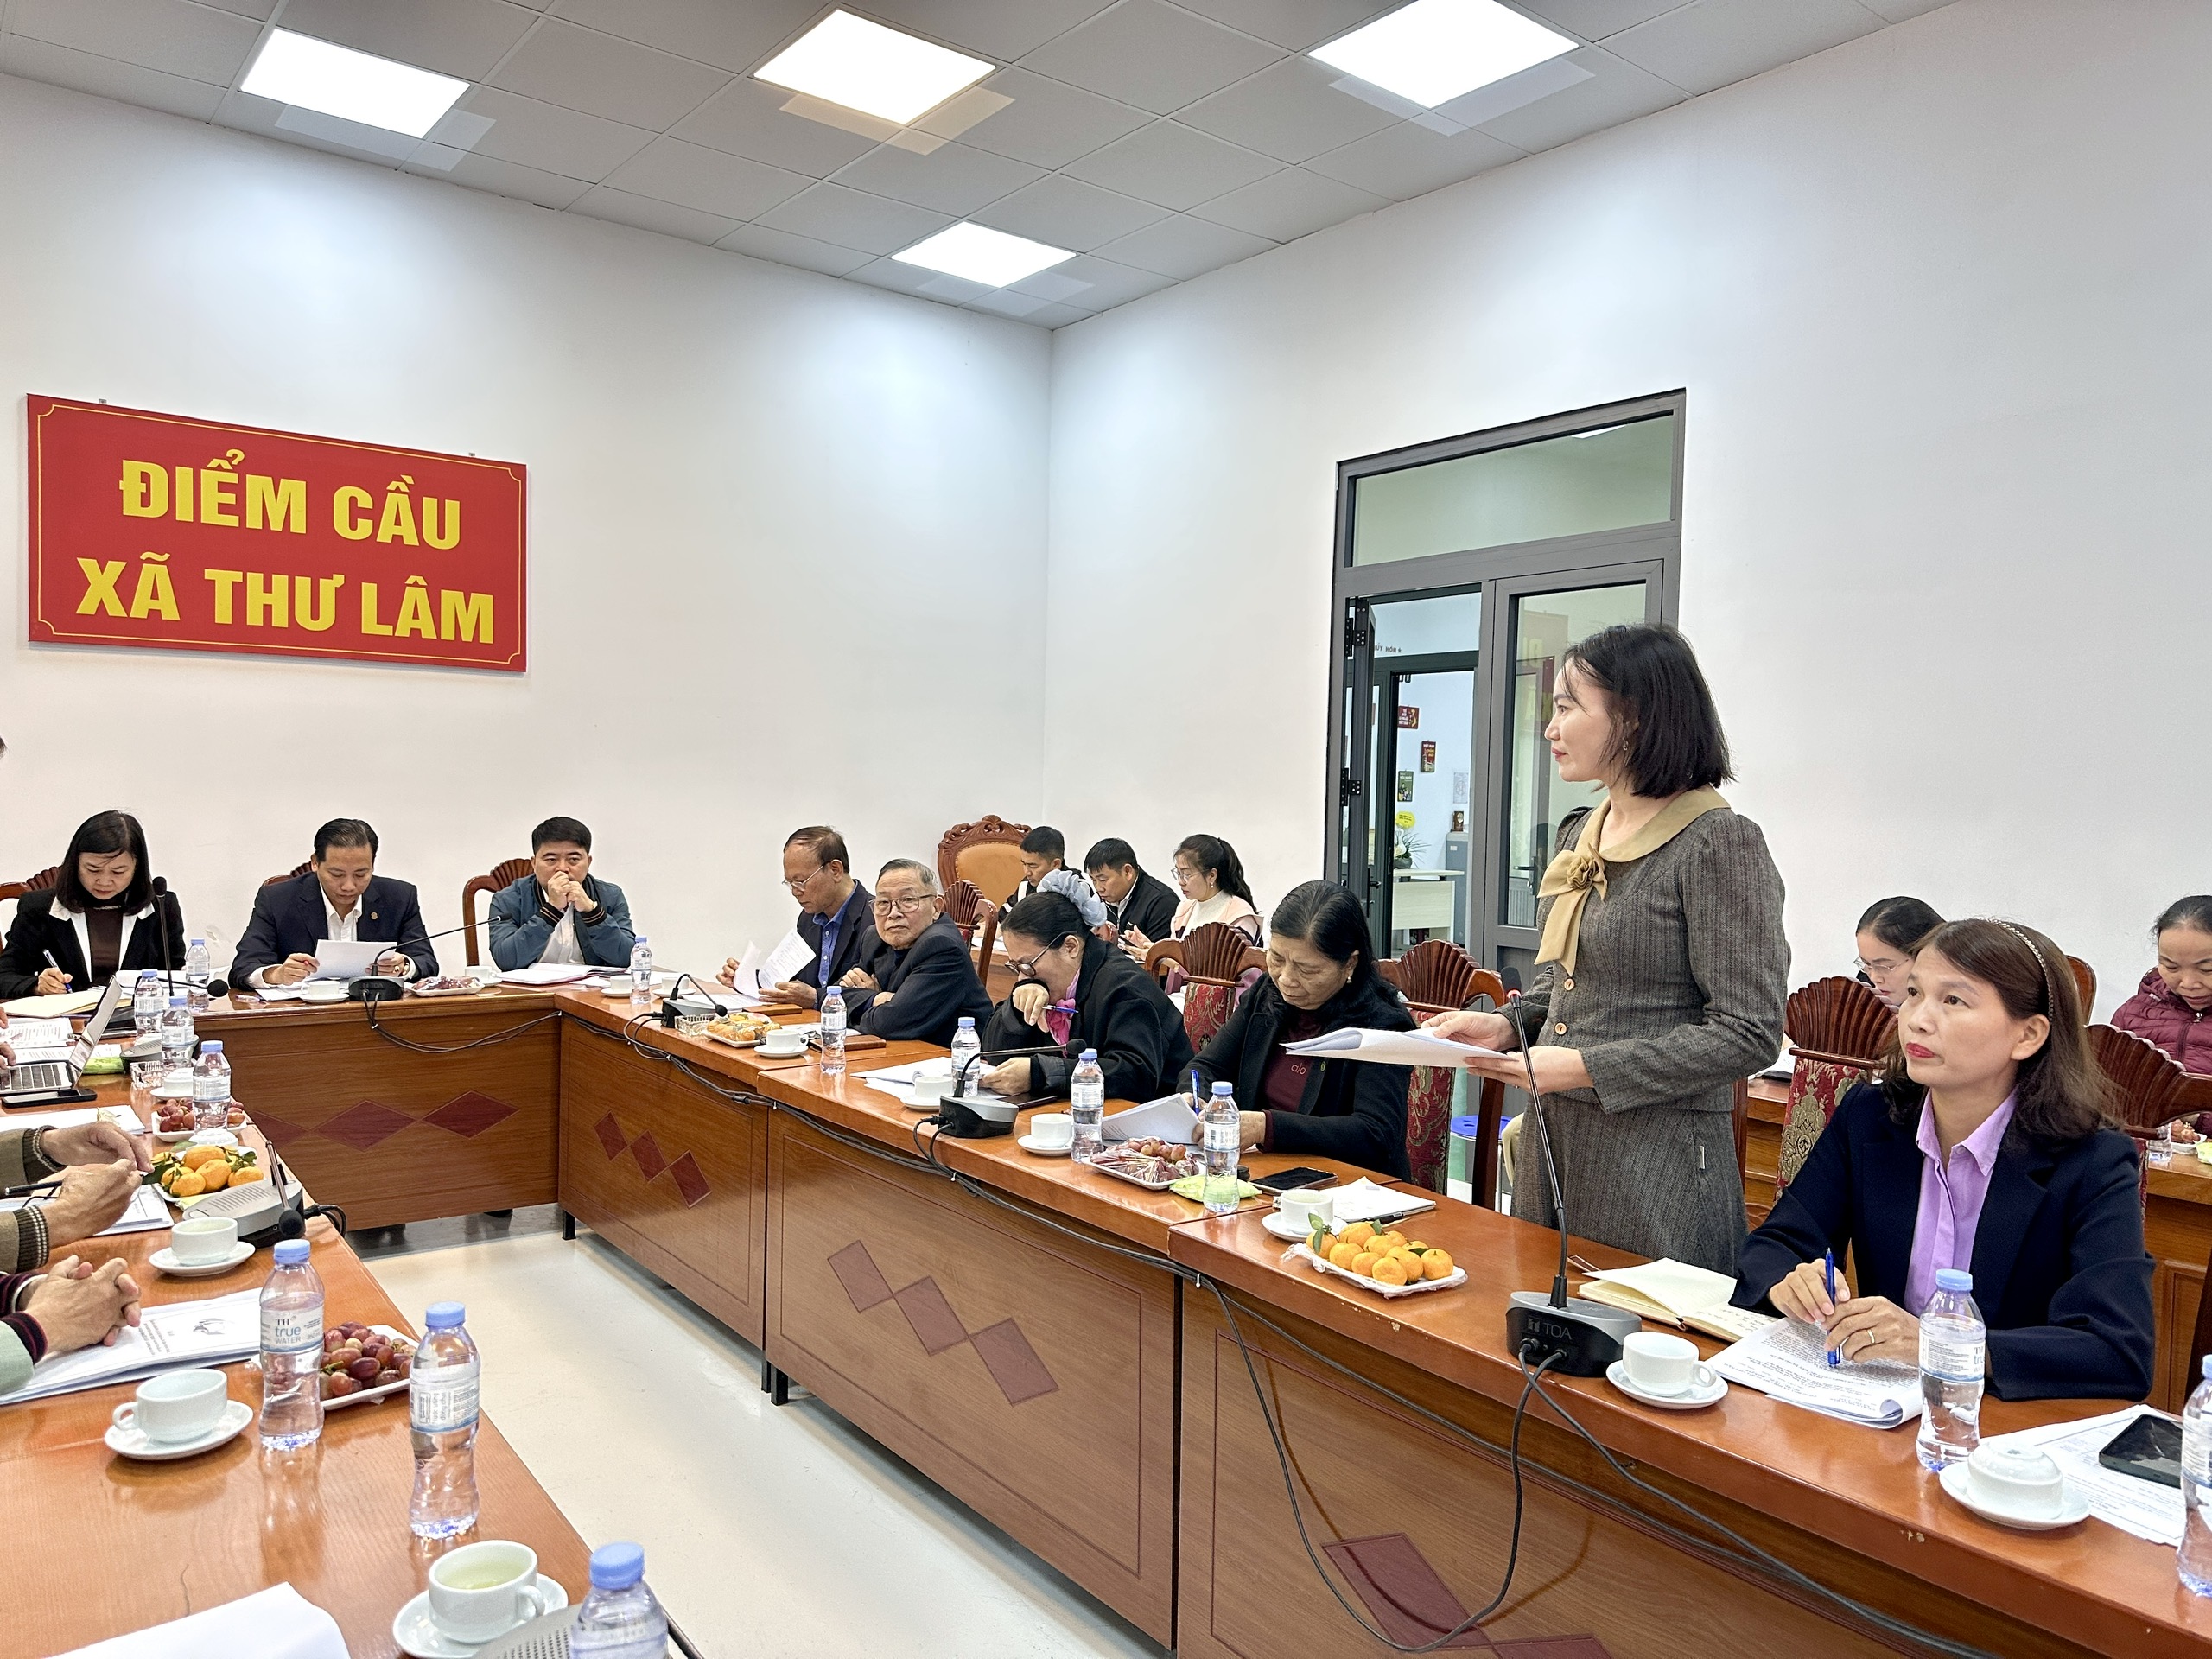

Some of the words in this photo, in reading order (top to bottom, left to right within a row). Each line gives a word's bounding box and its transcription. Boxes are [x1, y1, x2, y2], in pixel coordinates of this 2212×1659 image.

[119, 448, 307, 534] ĐIỂM
[333, 475, 461, 550] CẦU
[76, 551, 180, 621] XÃ
[204, 569, 345, 632] THƯ
[361, 575, 493, 644] LÂM
[1291, 1062, 1306, 1075] alo
[275, 1326, 302, 1338] true
[1542, 1322, 1573, 1340] TOA
[275, 1336, 302, 1344] WATER
